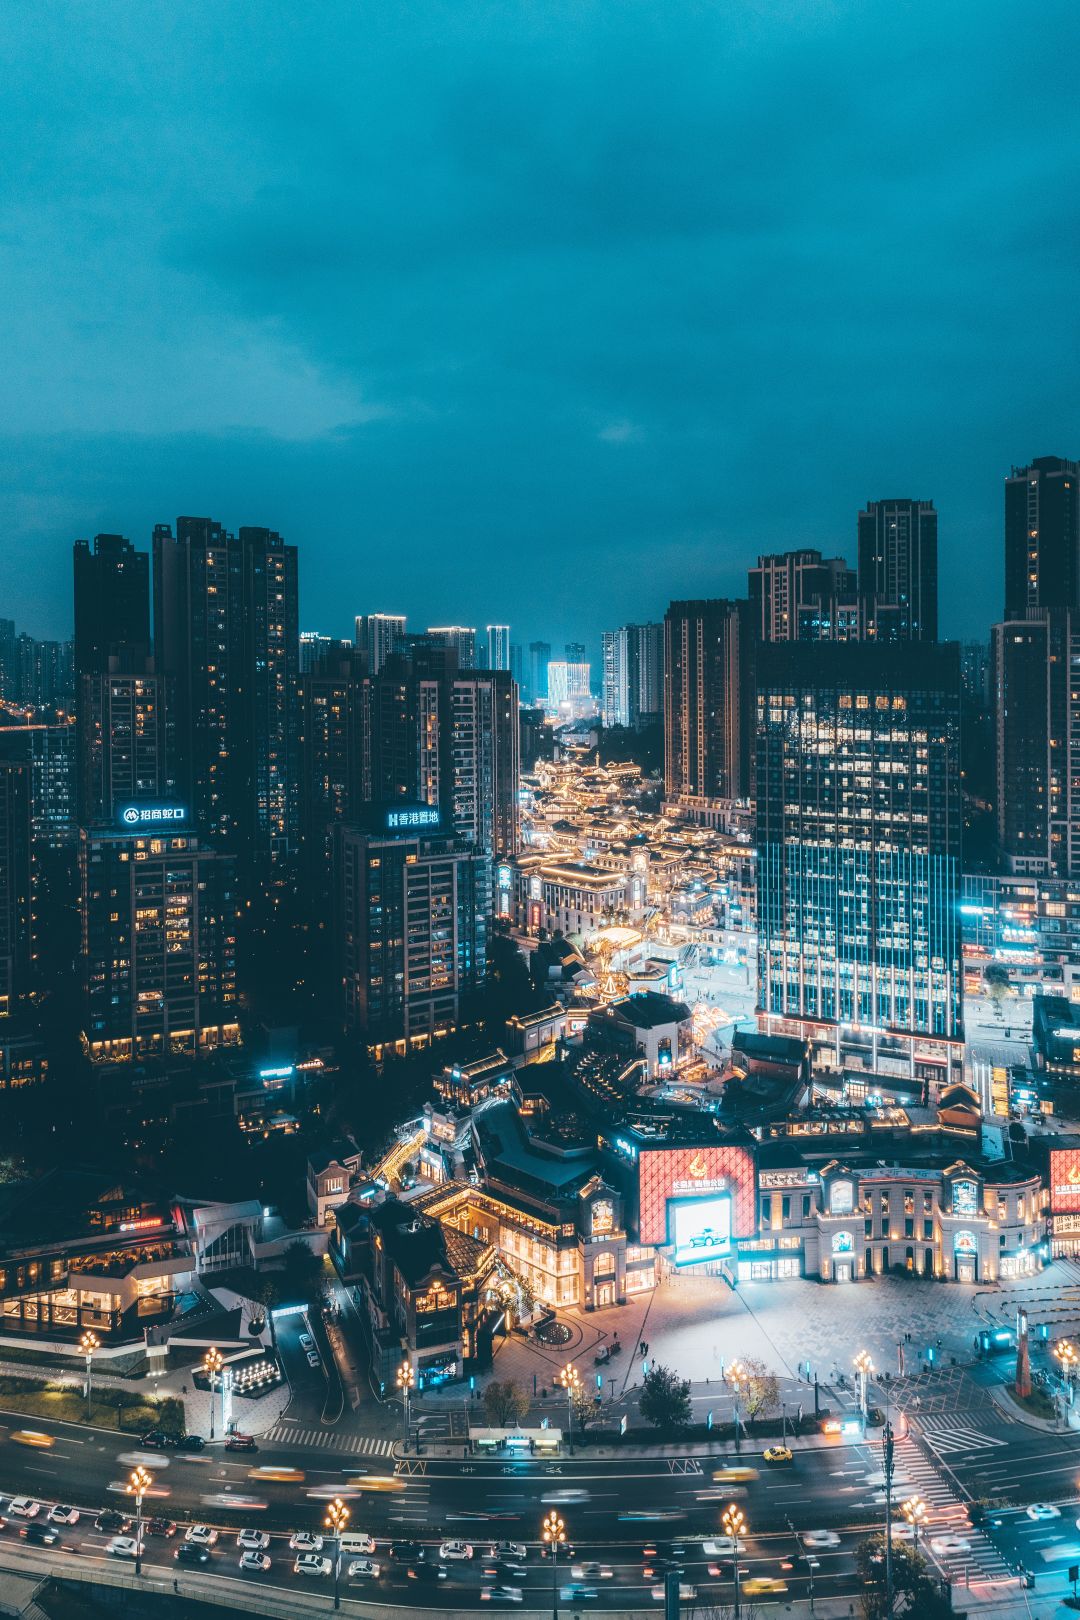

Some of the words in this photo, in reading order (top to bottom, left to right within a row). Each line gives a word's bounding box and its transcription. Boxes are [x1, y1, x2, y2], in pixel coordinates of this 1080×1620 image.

[140, 809, 184, 820] 招商蛇口
[399, 811, 439, 825] 香港置地
